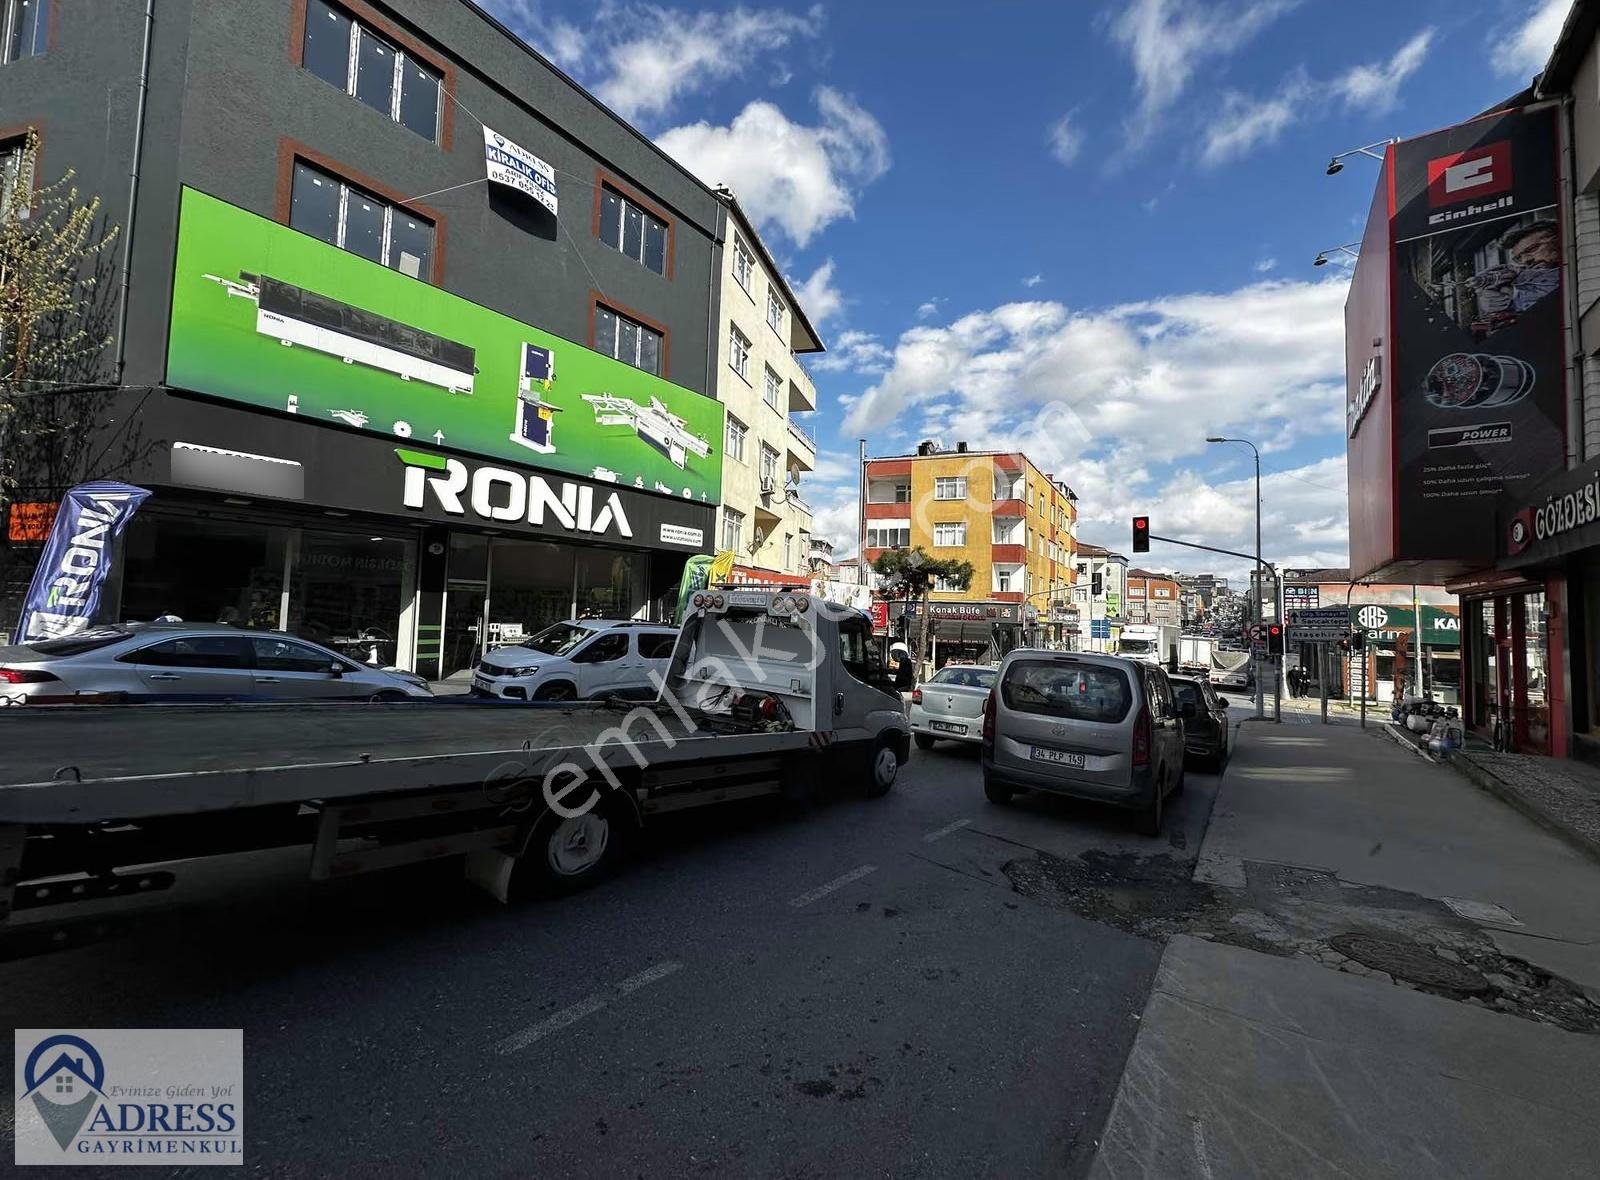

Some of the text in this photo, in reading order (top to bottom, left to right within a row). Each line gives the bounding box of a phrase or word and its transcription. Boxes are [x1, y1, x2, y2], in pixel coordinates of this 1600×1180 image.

[1428, 196, 1513, 224] Einhell
[1462, 428, 1508, 440] POWER
[394, 448, 633, 538] RONIA
[929, 605, 981, 615] Konak Büfe
[1292, 631, 1336, 639] Ataşehir
[1035, 749, 1045, 758] 34
[1068, 754, 1083, 765] 149
